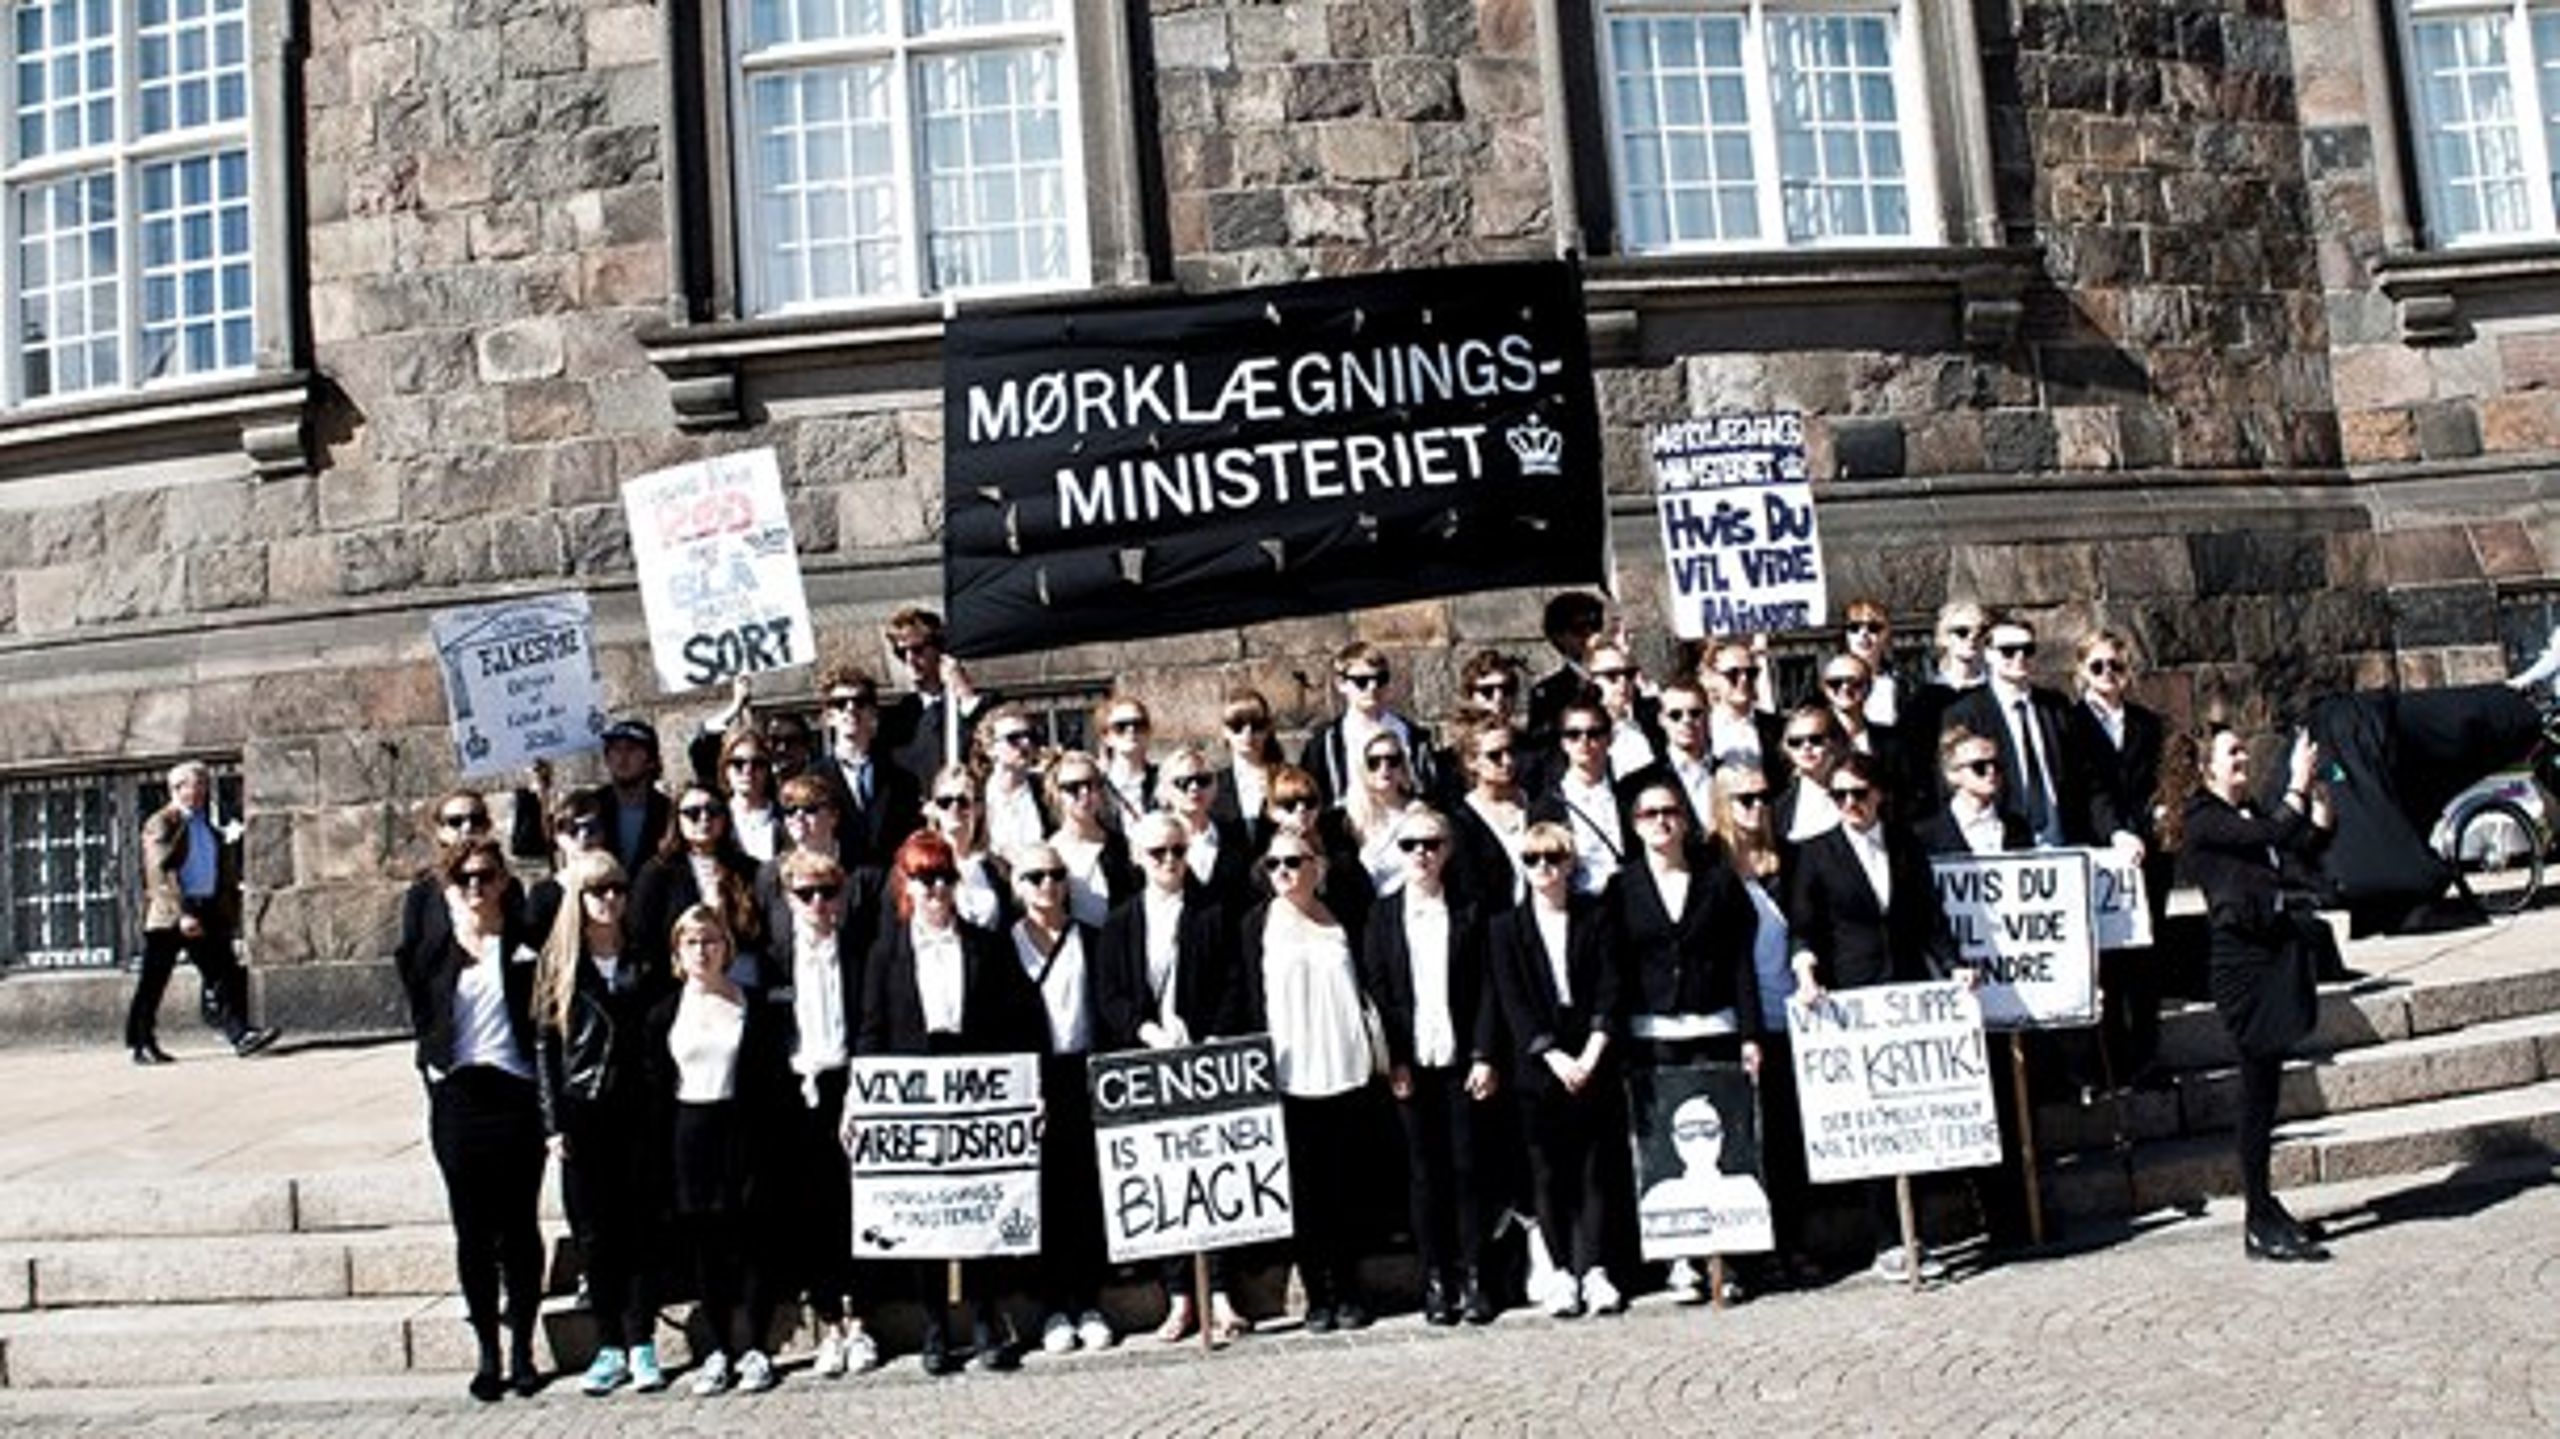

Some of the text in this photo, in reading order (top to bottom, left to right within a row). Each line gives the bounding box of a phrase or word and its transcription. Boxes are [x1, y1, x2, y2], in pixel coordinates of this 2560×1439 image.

[968, 334, 1562, 441] MØRKLÆGNINGS-
[1056, 424, 1487, 529] MINISTERIET
[683, 616, 791, 684] SORT
[2018, 867, 2057, 901] DU
[2096, 867, 2138, 914] 24
[1954, 910, 2066, 945] IL VIDE
[1972, 951, 2054, 986] NDRE
[1884, 984, 1967, 1029] SLIPPE
[944, 1068, 1011, 1104] HAVE
[1099, 1049, 1271, 1110] CENSUR
[1111, 1115, 1274, 1171] IS THE NEW
[1117, 1157, 1288, 1238] BLACK
